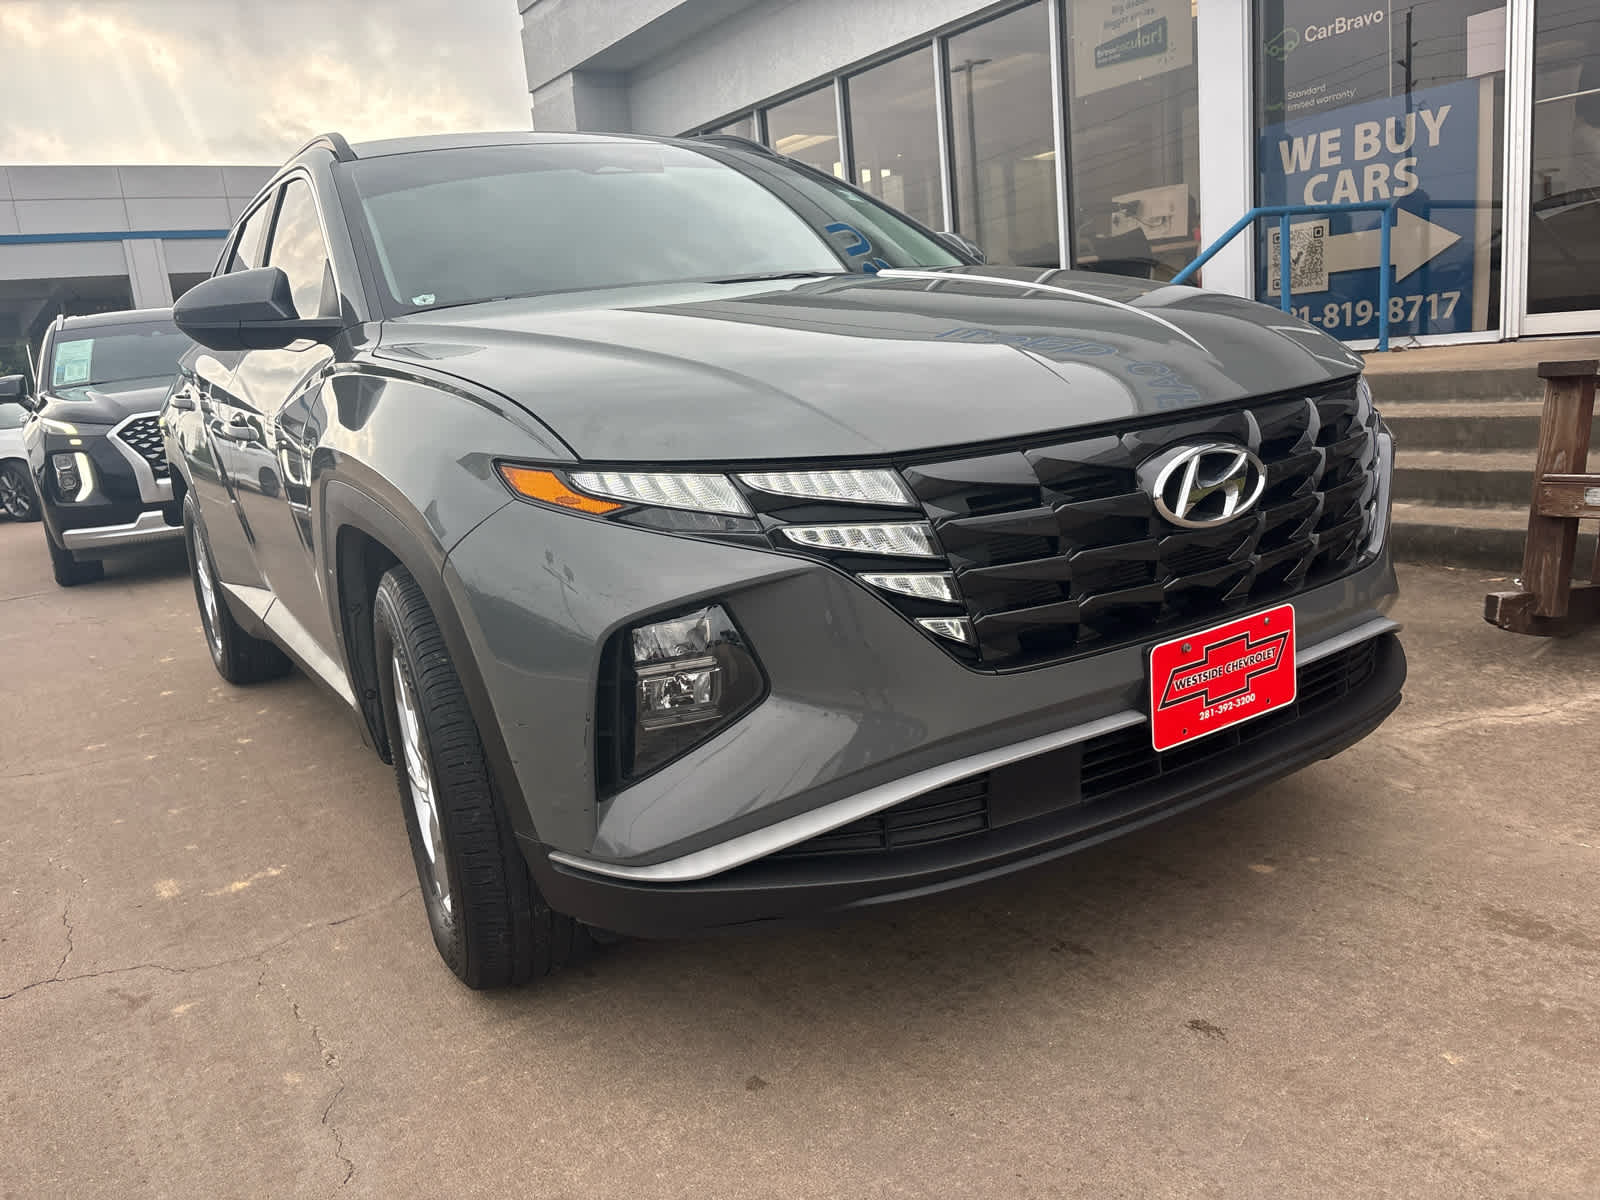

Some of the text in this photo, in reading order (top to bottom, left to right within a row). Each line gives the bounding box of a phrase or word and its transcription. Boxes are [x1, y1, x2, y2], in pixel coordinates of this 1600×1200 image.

[1304, 10, 1384, 42] CarBravo
[1287, 83, 1326, 100] Standard
[1279, 105, 1452, 175] WE BUY
[1303, 157, 1419, 205] CARS
[1174, 647, 1277, 691] WESTSIDE CHEVROLET
[1199, 693, 1256, 721] 281-392-3200
